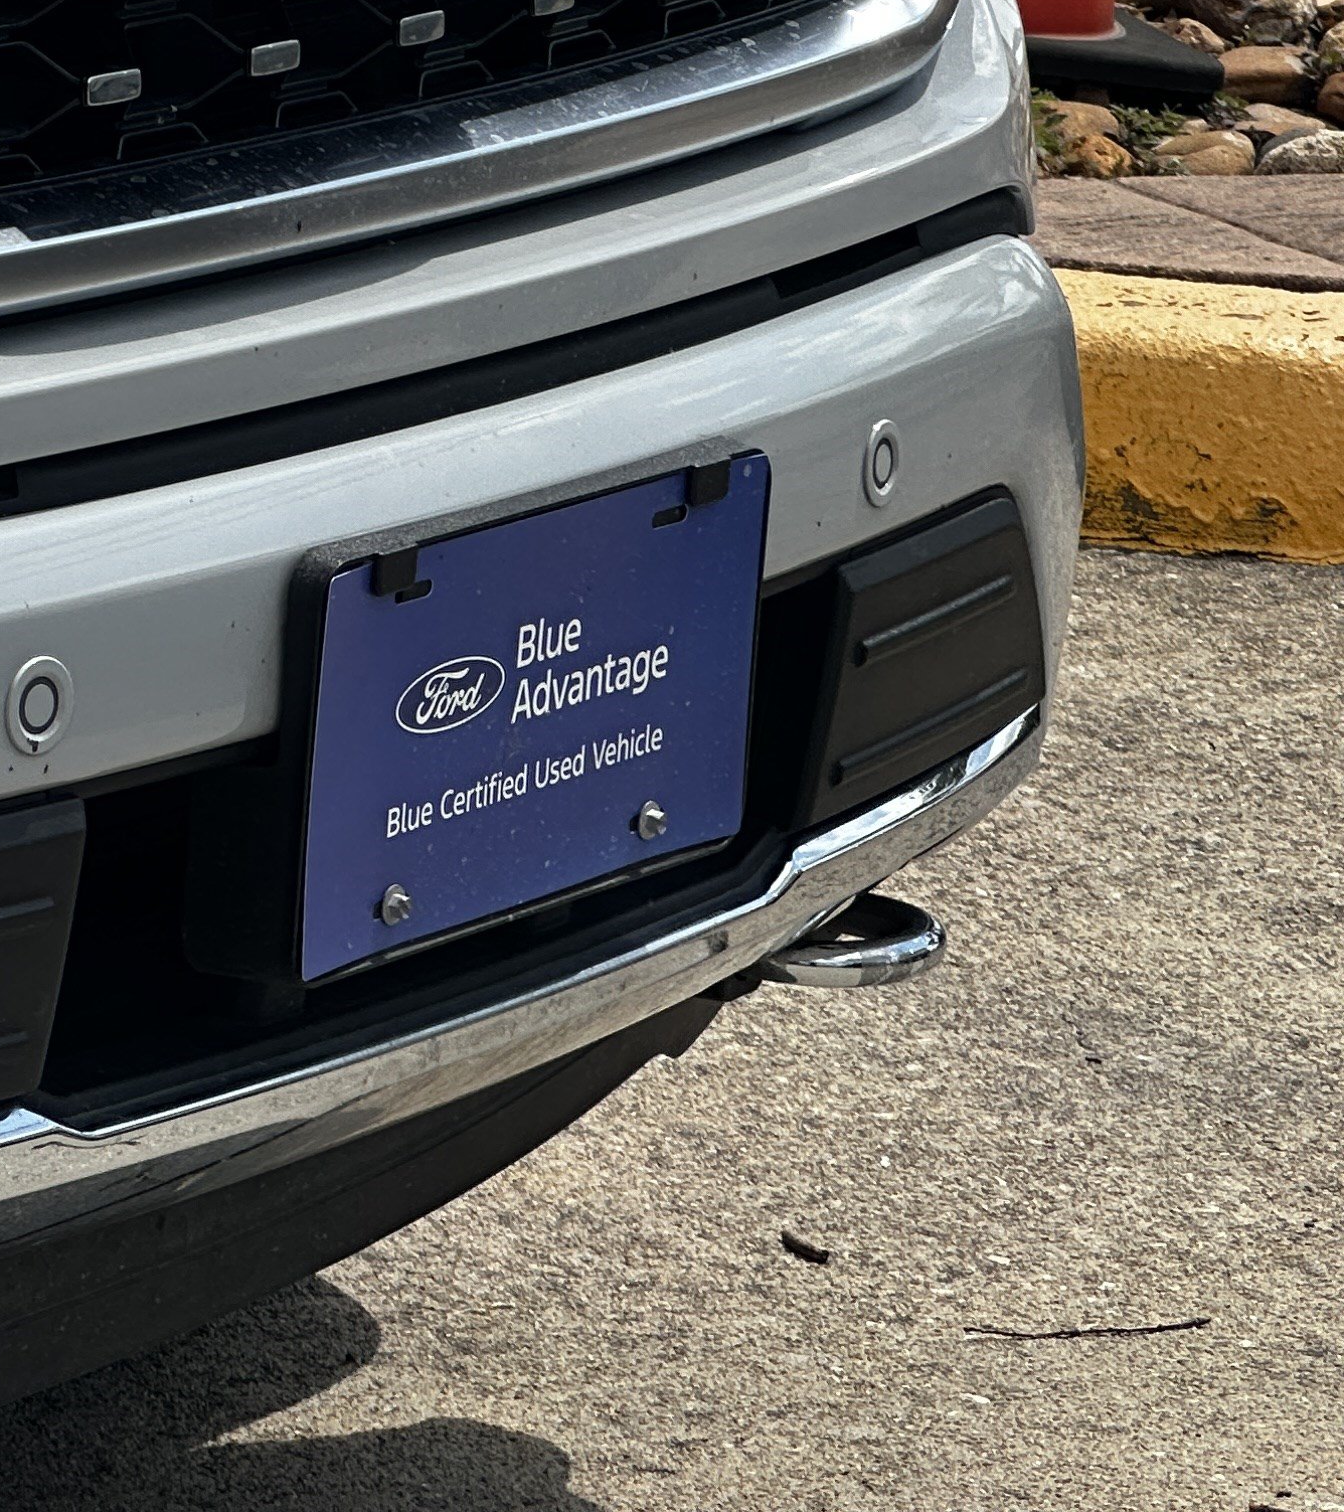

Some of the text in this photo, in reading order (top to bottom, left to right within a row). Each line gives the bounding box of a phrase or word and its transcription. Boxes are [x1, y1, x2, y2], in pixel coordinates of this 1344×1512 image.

[516, 618, 582, 668] Blue
[415, 667, 485, 725] Ford
[510, 644, 669, 724] Advantage
[386, 724, 663, 838] Blue Certified Used Vehicle
